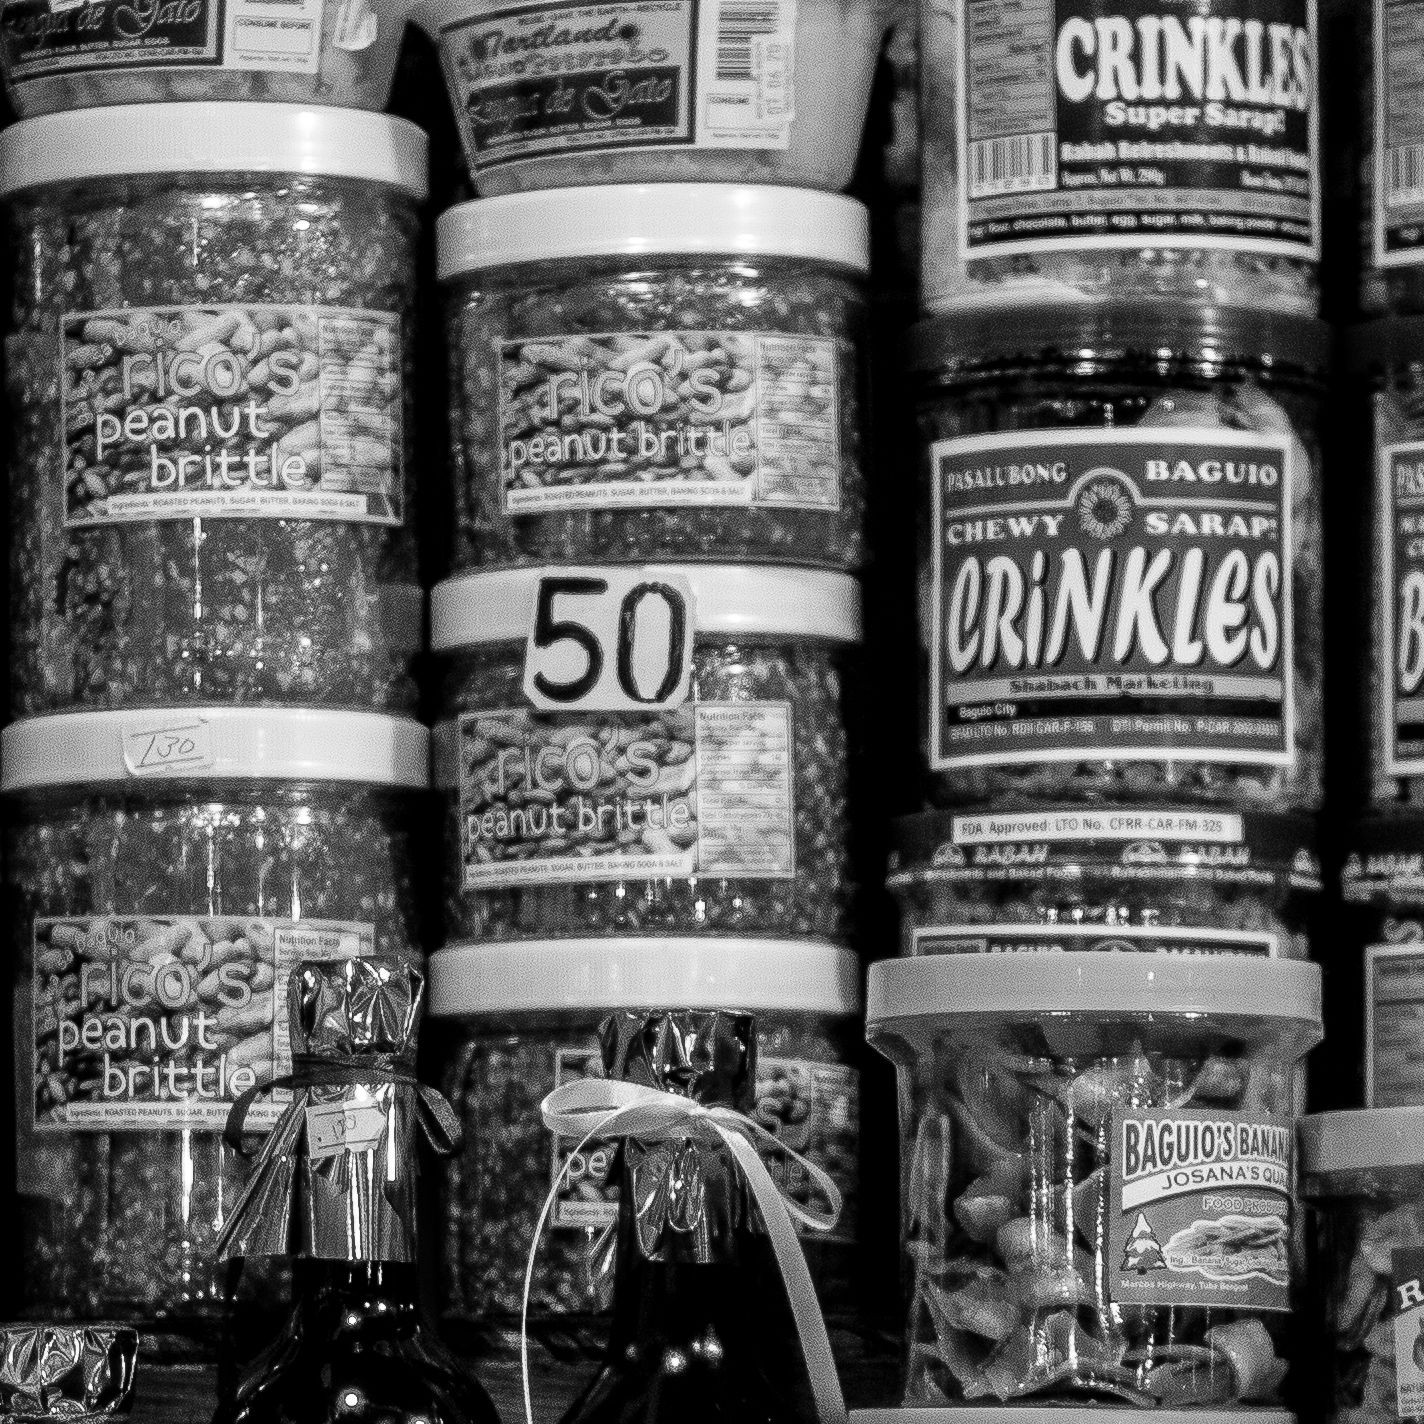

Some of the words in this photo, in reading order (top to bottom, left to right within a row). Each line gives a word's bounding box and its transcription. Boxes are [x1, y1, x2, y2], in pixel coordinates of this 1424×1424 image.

[96, 400, 270, 461] peanut
[508, 427, 629, 478] peanut
[636, 420, 752, 458] brittle
[150, 442, 307, 487] brittle
[1145, 460, 1278, 485] BAGUIO
[532, 576, 686, 703] 50
[467, 800, 566, 840] peanut
[579, 792, 690, 831] brittle
[58, 1010, 218, 1067] peanut
[103, 1053, 256, 1099] brittle
[1123, 1119, 1235, 1180] BAGUIO'S
[1161, 1165, 1260, 1190] JOSANA'S
